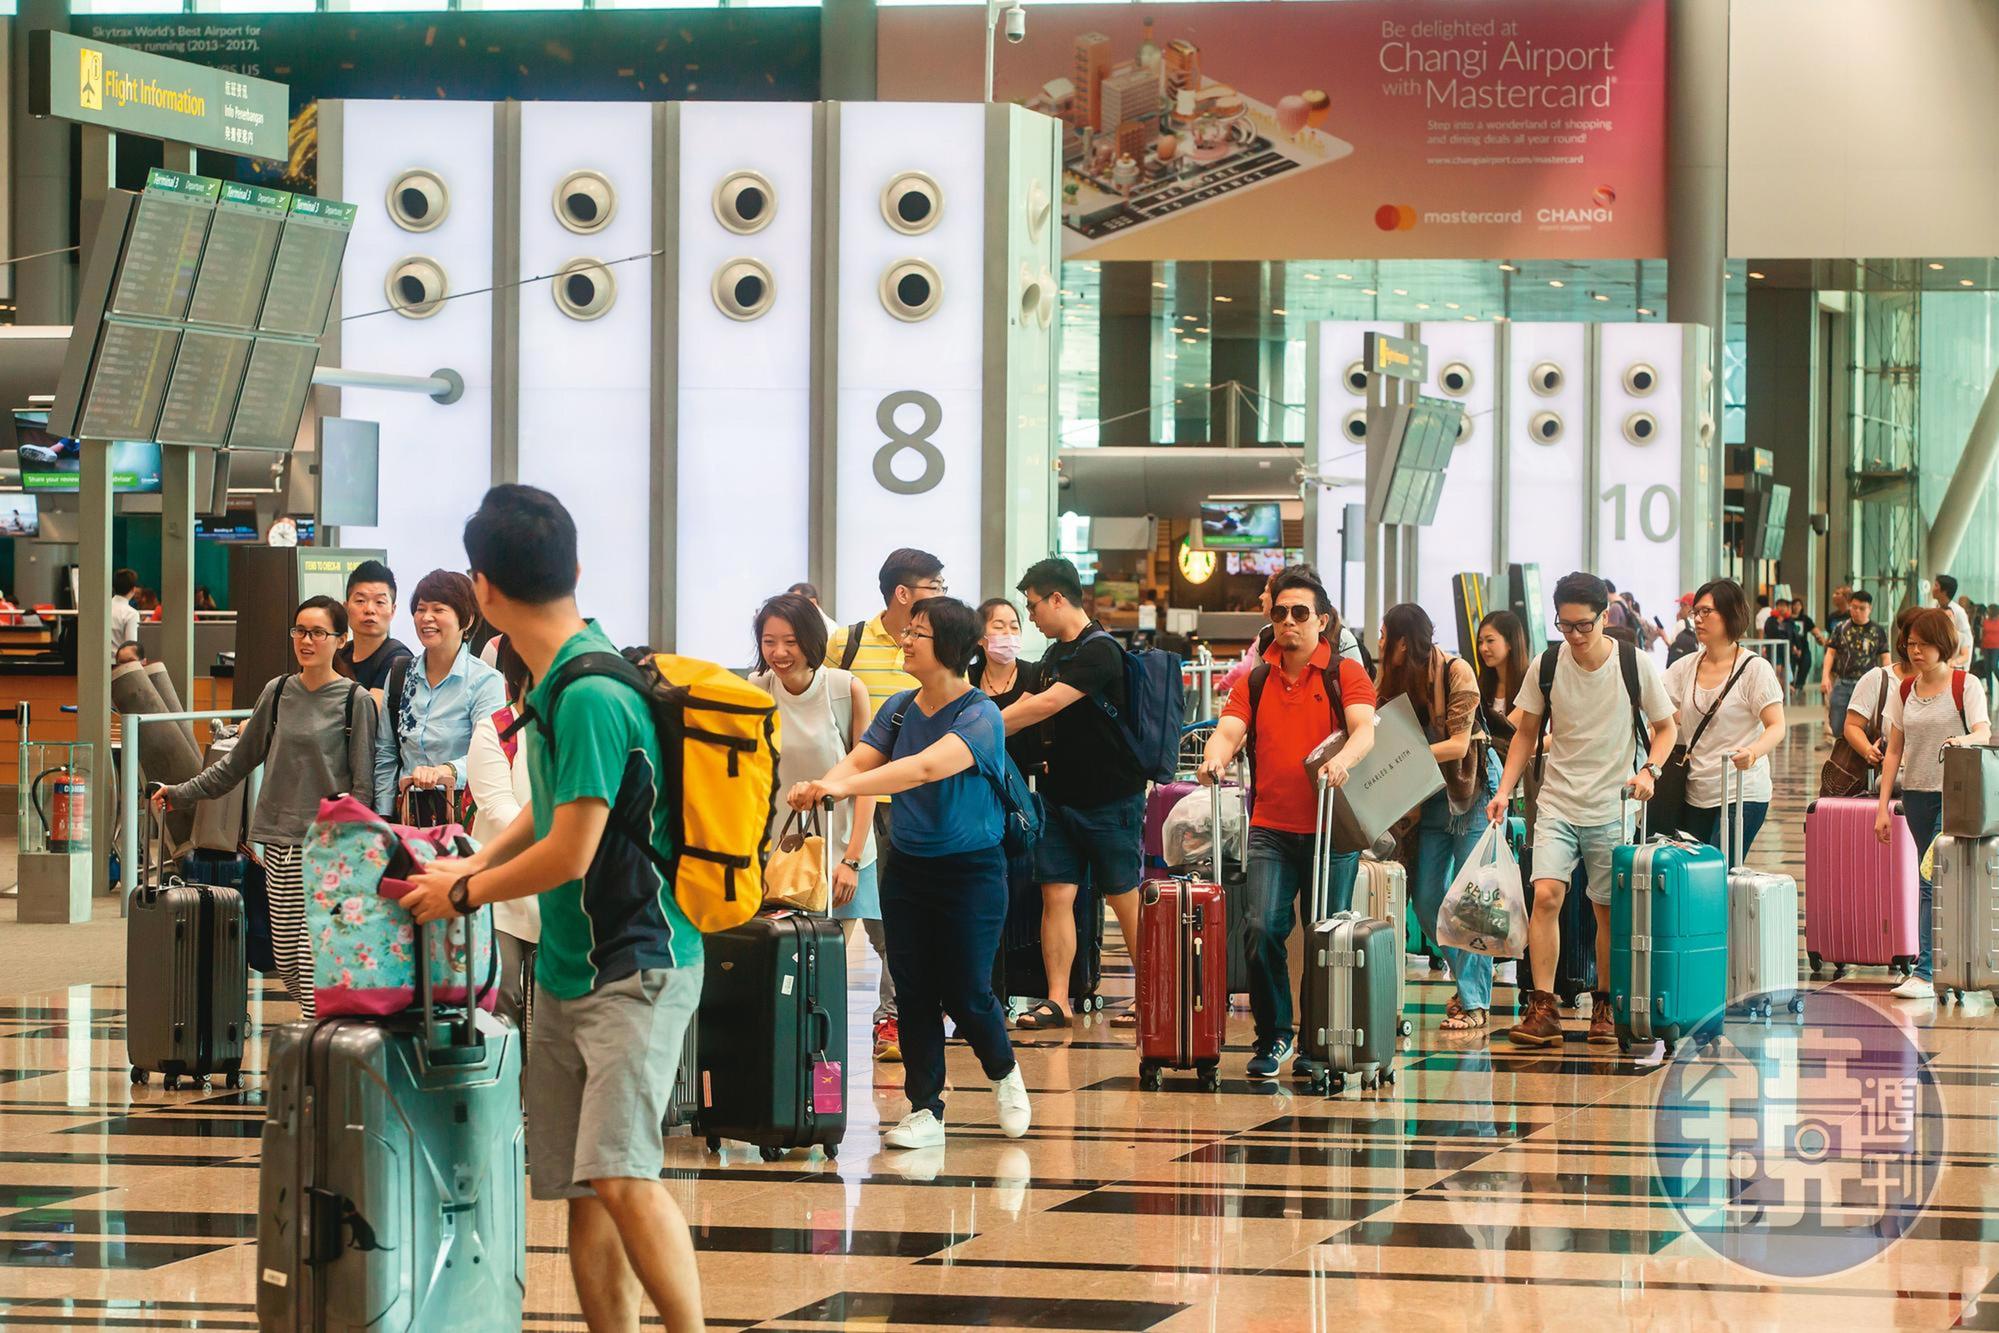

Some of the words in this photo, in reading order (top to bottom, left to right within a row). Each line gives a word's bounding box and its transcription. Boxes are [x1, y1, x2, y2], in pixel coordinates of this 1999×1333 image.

[92, 26, 132, 39] Skytrax
[135, 25, 176, 37] World's
[177, 25, 201, 37] Best
[204, 25, 242, 38] Airport
[245, 25, 261, 37] for
[1382, 20, 1406, 38] Be
[1411, 19, 1496, 40] delighted
[1501, 21, 1518, 37] at
[145, 41, 185, 53] running
[1379, 40, 1488, 79] Changi
[1499, 40, 1615, 78] Airport
[105, 70, 138, 107] Flight
[140, 78, 206, 118] Information
[1382, 79, 1422, 96] with
[1427, 119, 1450, 131] Step
[1454, 119, 1473, 130] into
[1486, 119, 1547, 130] wonderland
[1550, 119, 1563, 130] of
[1565, 119, 1613, 131] shopping
[1427, 134, 1447, 144] and
[1450, 133, 1481, 146] dining
[1484, 134, 1511, 145] deals
[1513, 134, 1525, 144] all
[1527, 135, 1551, 145] year
[1424, 209, 1522, 224] mastercard
[872, 389, 946, 495] 8
[1600, 484, 1679, 543] 10
[1363, 768, 1388, 791] CHARLES
[1395, 749, 1412, 766] KEITH
